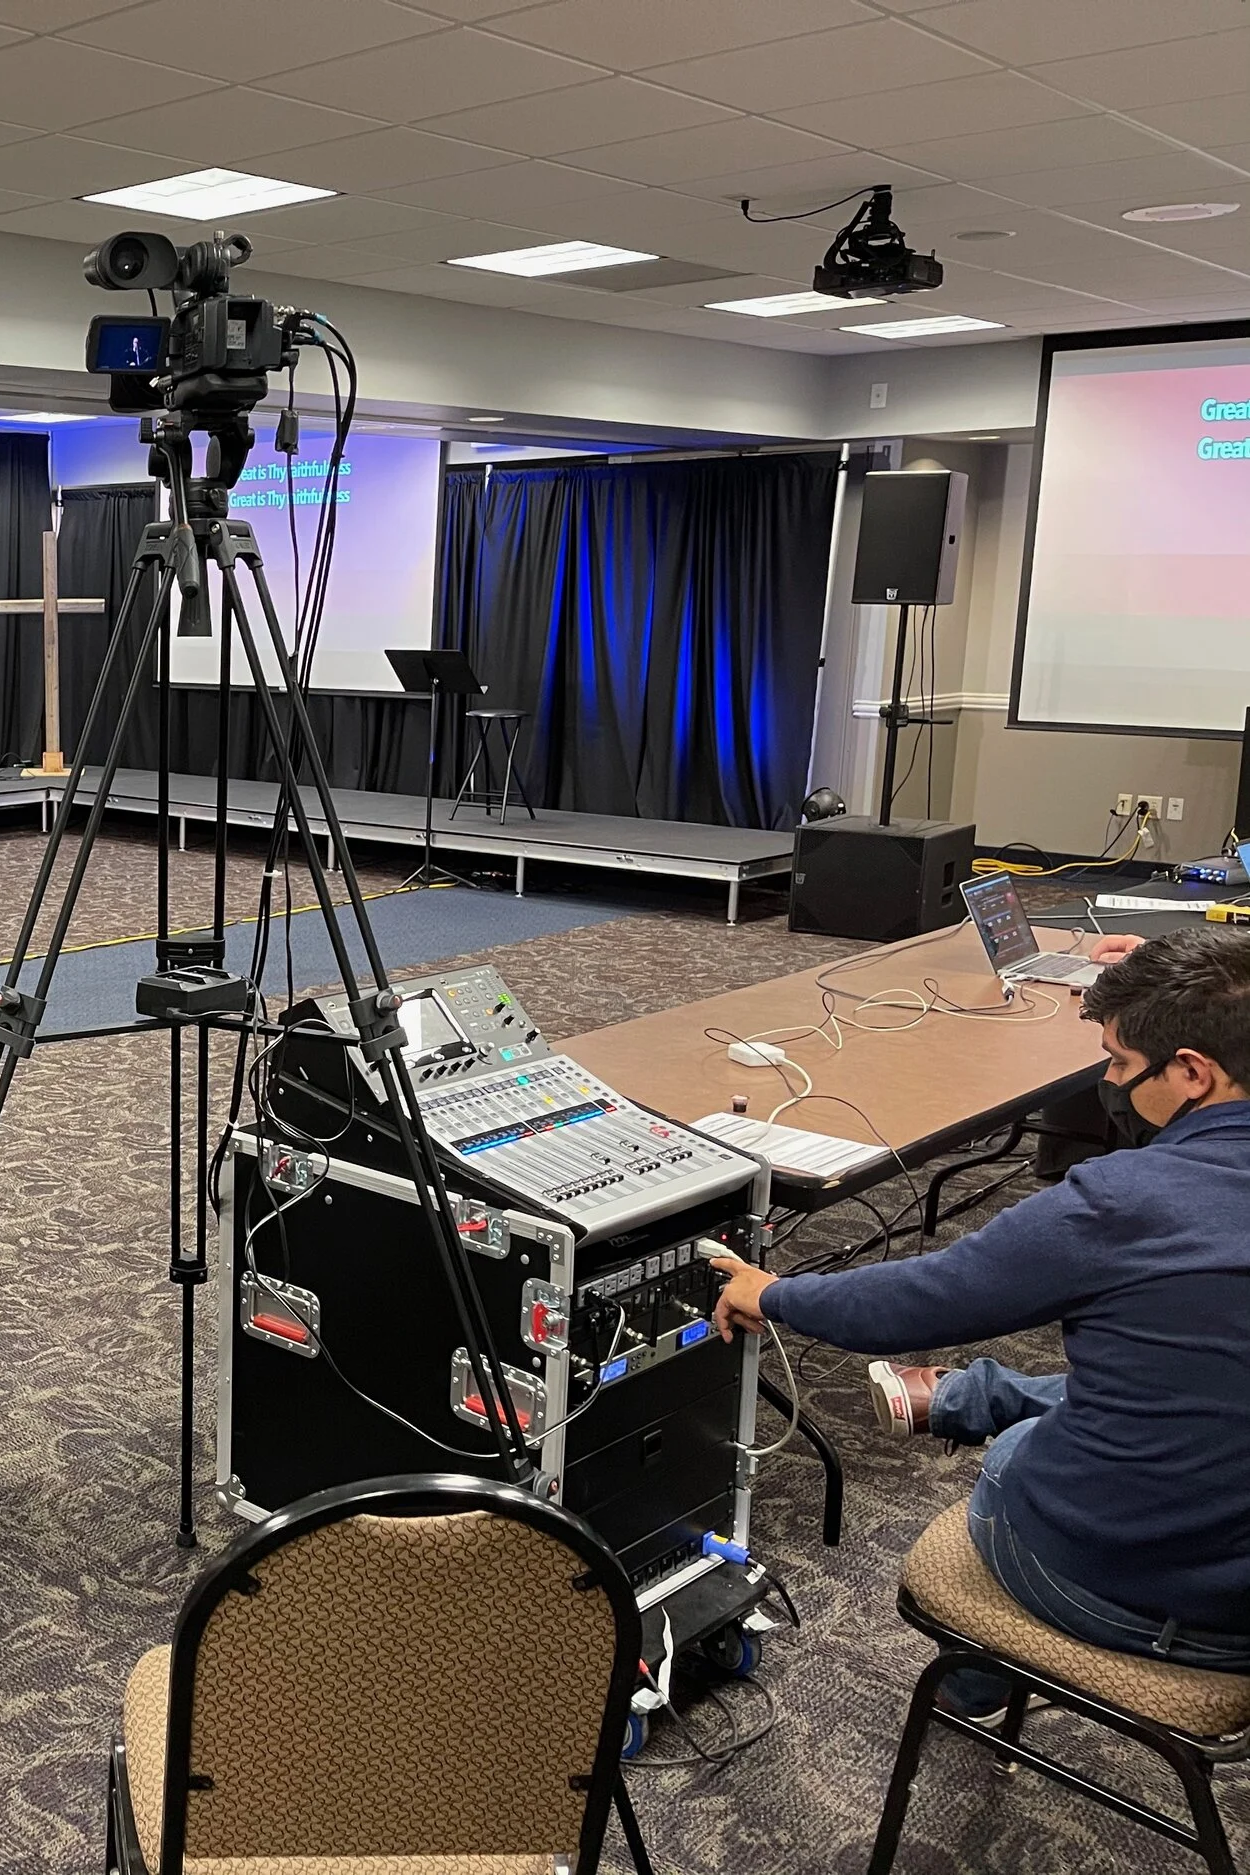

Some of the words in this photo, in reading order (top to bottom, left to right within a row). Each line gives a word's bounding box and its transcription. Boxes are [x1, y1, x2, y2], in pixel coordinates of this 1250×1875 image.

[240, 466, 257, 481] eat
[258, 464, 267, 480] is
[267, 463, 287, 483] Thy
[290, 460, 351, 478] aithfulss
[229, 492, 257, 507] Great
[257, 490, 266, 506] is
[266, 489, 286, 510] Thy
